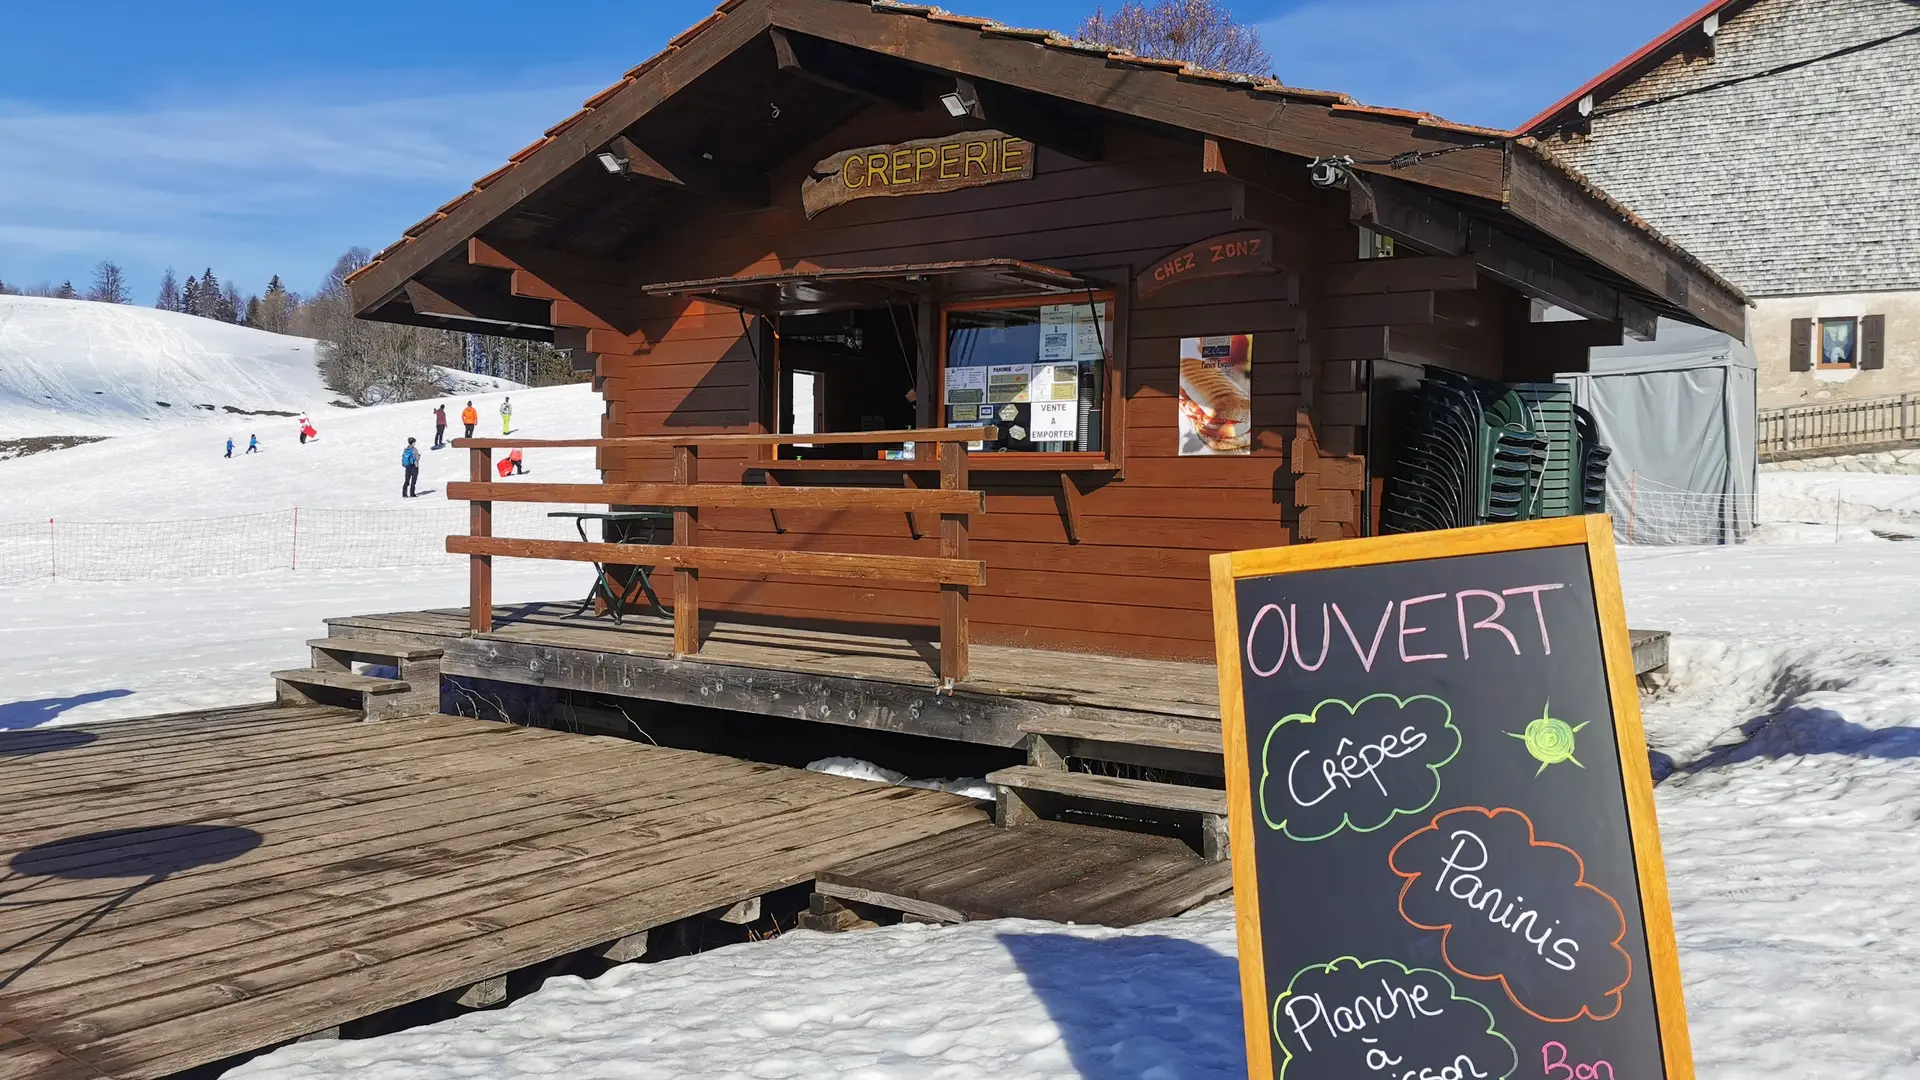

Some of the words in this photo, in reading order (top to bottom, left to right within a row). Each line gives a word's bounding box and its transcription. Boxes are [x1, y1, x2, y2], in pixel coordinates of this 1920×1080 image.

[842, 136, 1024, 189] CREPERIE
[1154, 252, 1196, 280] CHEZ
[1210, 239, 1261, 262] ZONZ
[1041, 403, 1067, 412] VENTE
[1051, 417, 1056, 425] A
[1032, 430, 1074, 439] EMPORTER
[1247, 583, 1564, 677] OUVERT
[1288, 726, 1428, 806] Crêpes
[1435, 830, 1579, 971] Paninis
[1285, 978, 1443, 1052] Planche
[1362, 1037, 1403, 1070] à
[1542, 1041, 1615, 1080] Bon
